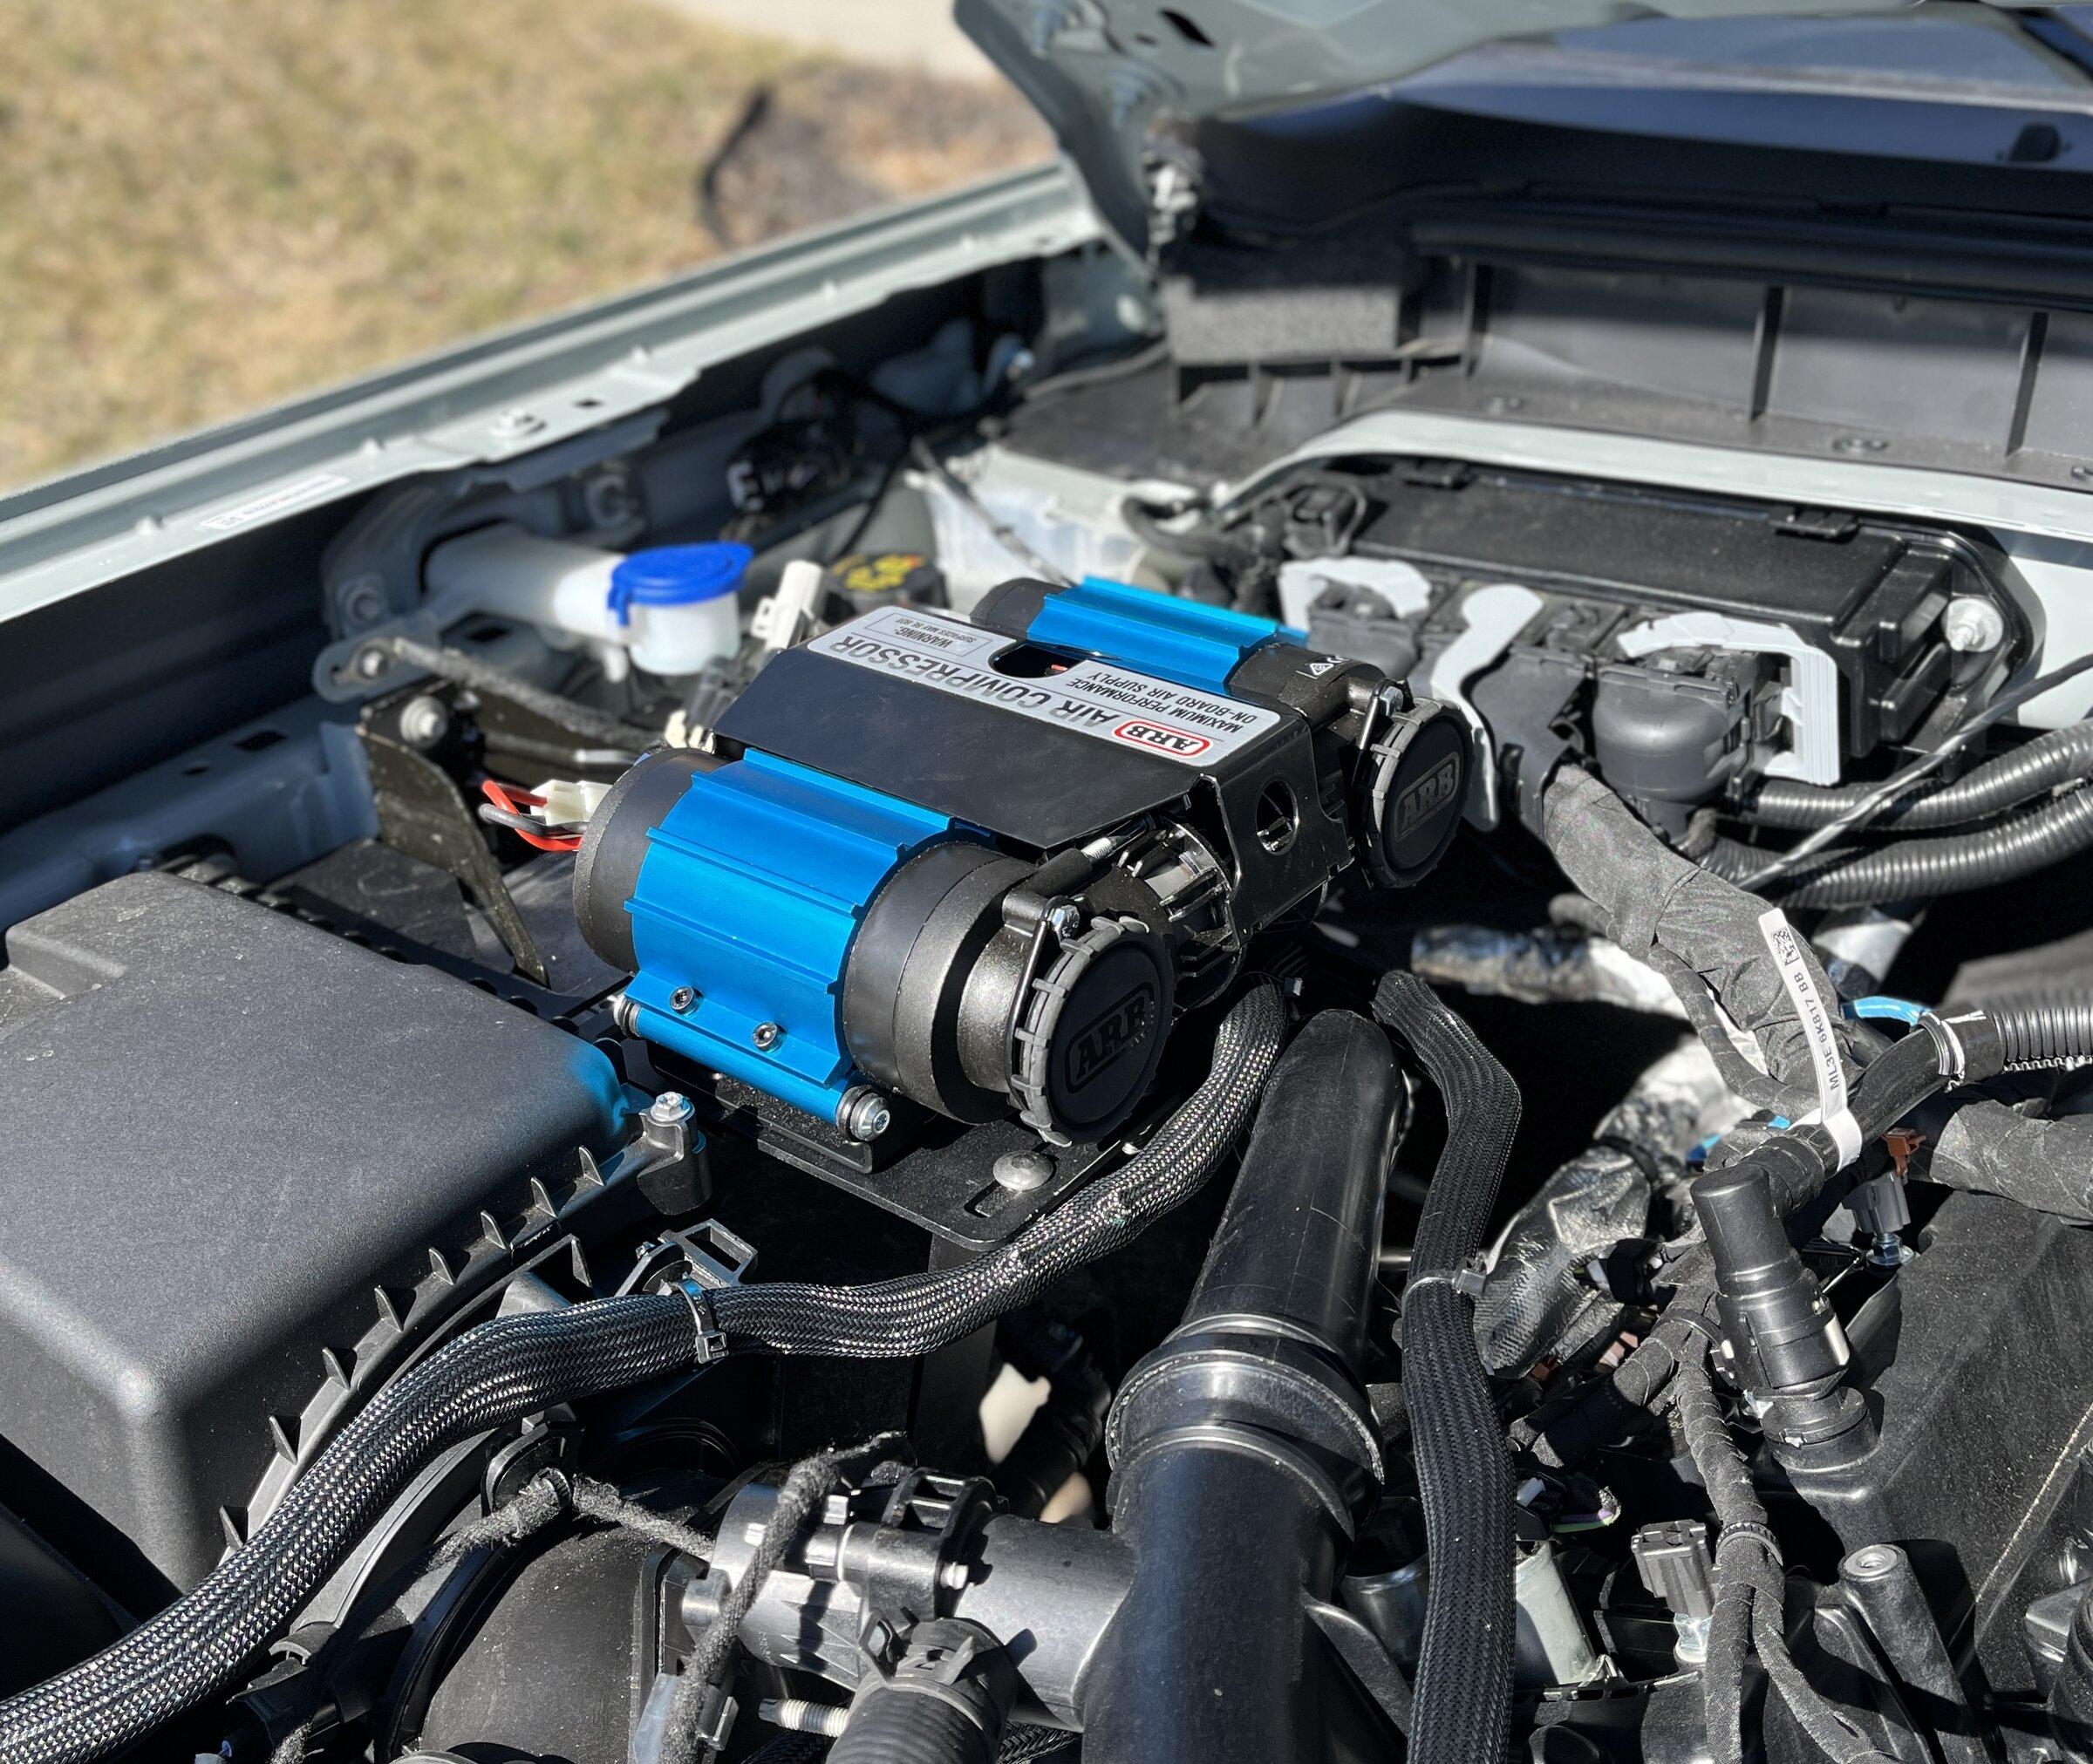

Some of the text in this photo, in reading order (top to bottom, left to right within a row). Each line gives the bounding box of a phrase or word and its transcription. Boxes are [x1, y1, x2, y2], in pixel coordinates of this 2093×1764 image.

[895, 626, 953, 648] WARNING:
[829, 635, 1121, 728] AIR COMPRESSOR
[1066, 678, 1244, 733] MAXIMUM PERFORMANCE
[1089, 671, 1258, 724] ON-BOARD AIR SUPPLY
[1126, 725, 1202, 752] ARB
[1401, 764, 1456, 832] ARB
[1076, 996, 1146, 1081] ARB
[1794, 971, 1840, 1091] ML3E 6K817 BB
